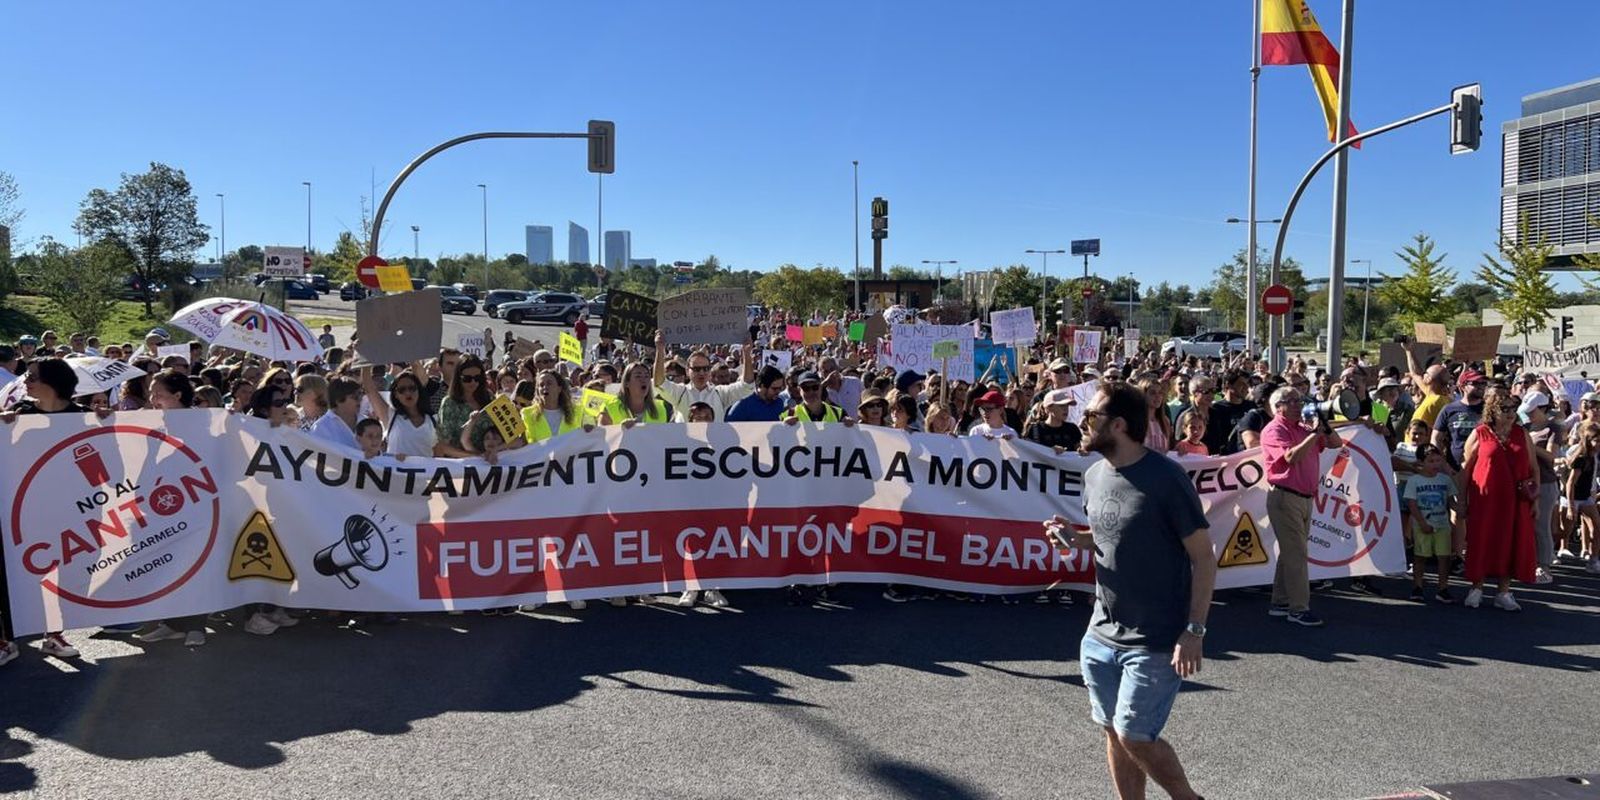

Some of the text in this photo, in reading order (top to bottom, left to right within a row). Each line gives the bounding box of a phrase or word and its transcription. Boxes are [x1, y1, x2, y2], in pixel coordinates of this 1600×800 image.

[266, 255, 280, 266] NO
[610, 293, 659, 318] CANTO
[663, 309, 688, 321] CON
[694, 307, 709, 318] EL
[895, 325, 958, 338] ALMEIDA
[895, 353, 918, 367] NO
[1525, 347, 1543, 368] NO
[500, 404, 511, 416] NO
[244, 441, 649, 498] AYUNTAMIENTO,
[664, 445, 871, 480] ESCUCHA
[884, 451, 915, 483] A
[1319, 474, 1351, 496] NO AL
[76, 479, 141, 514] NO AL
[87, 521, 188, 576] MONTECARMELO
[438, 514, 1093, 578] FUERA EL CANTÓN DEL BARRI
[1307, 535, 1331, 549] ADRID
[124, 553, 173, 582] MADRID
